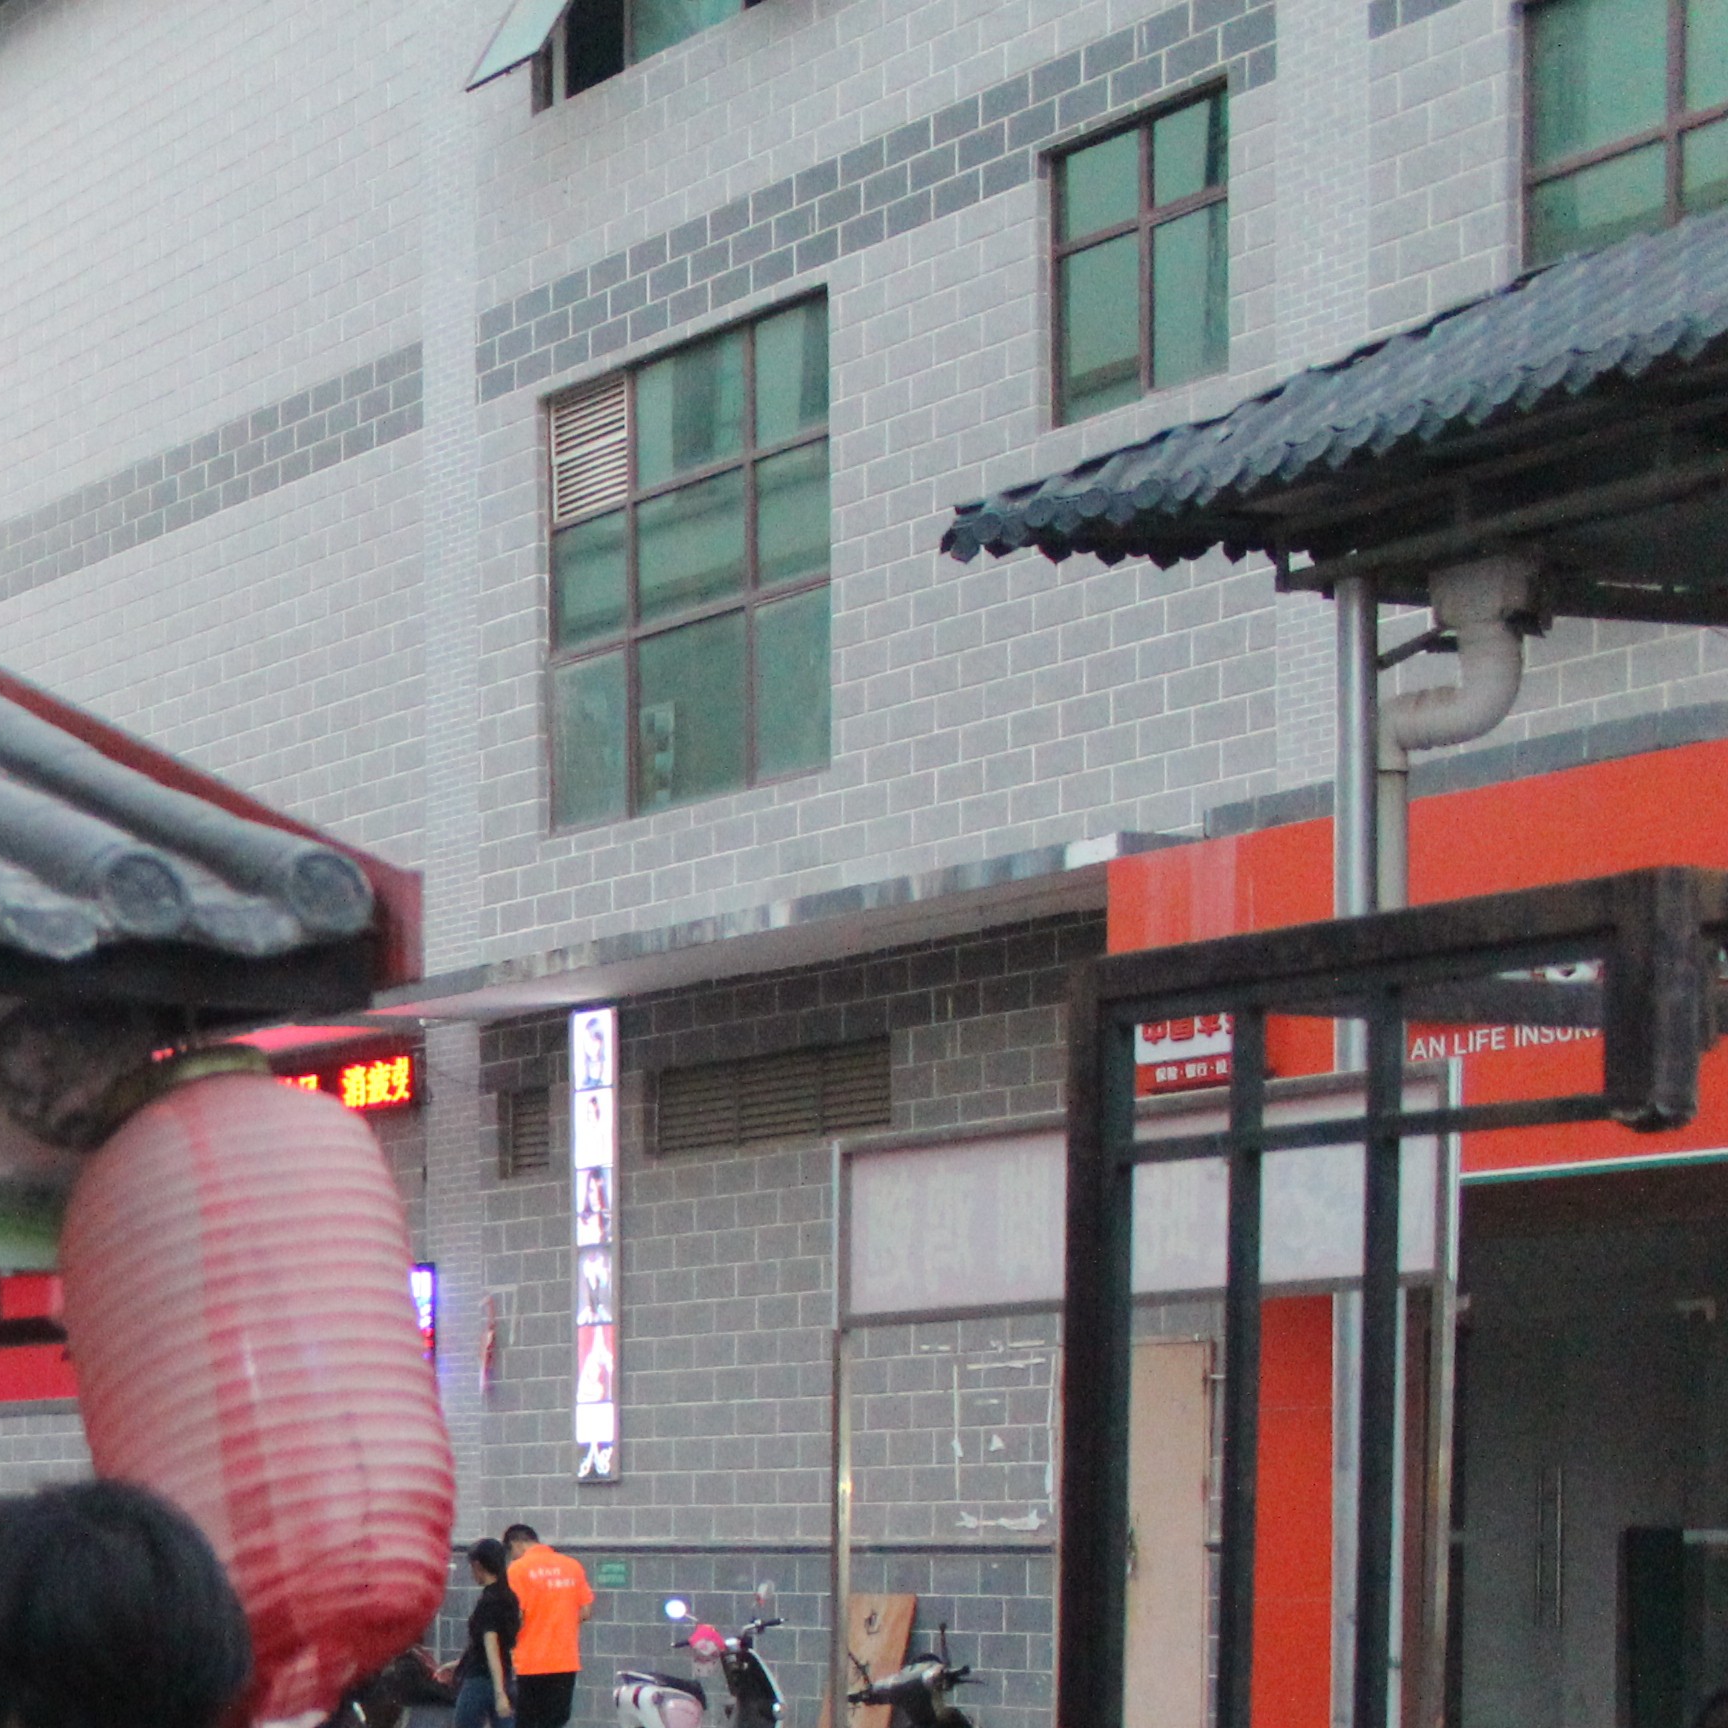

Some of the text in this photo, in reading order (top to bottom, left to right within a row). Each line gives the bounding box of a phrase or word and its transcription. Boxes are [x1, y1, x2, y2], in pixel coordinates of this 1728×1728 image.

[1141, 1013, 1234, 1045] 中国平
[1453, 1027, 1506, 1055] LIFE
